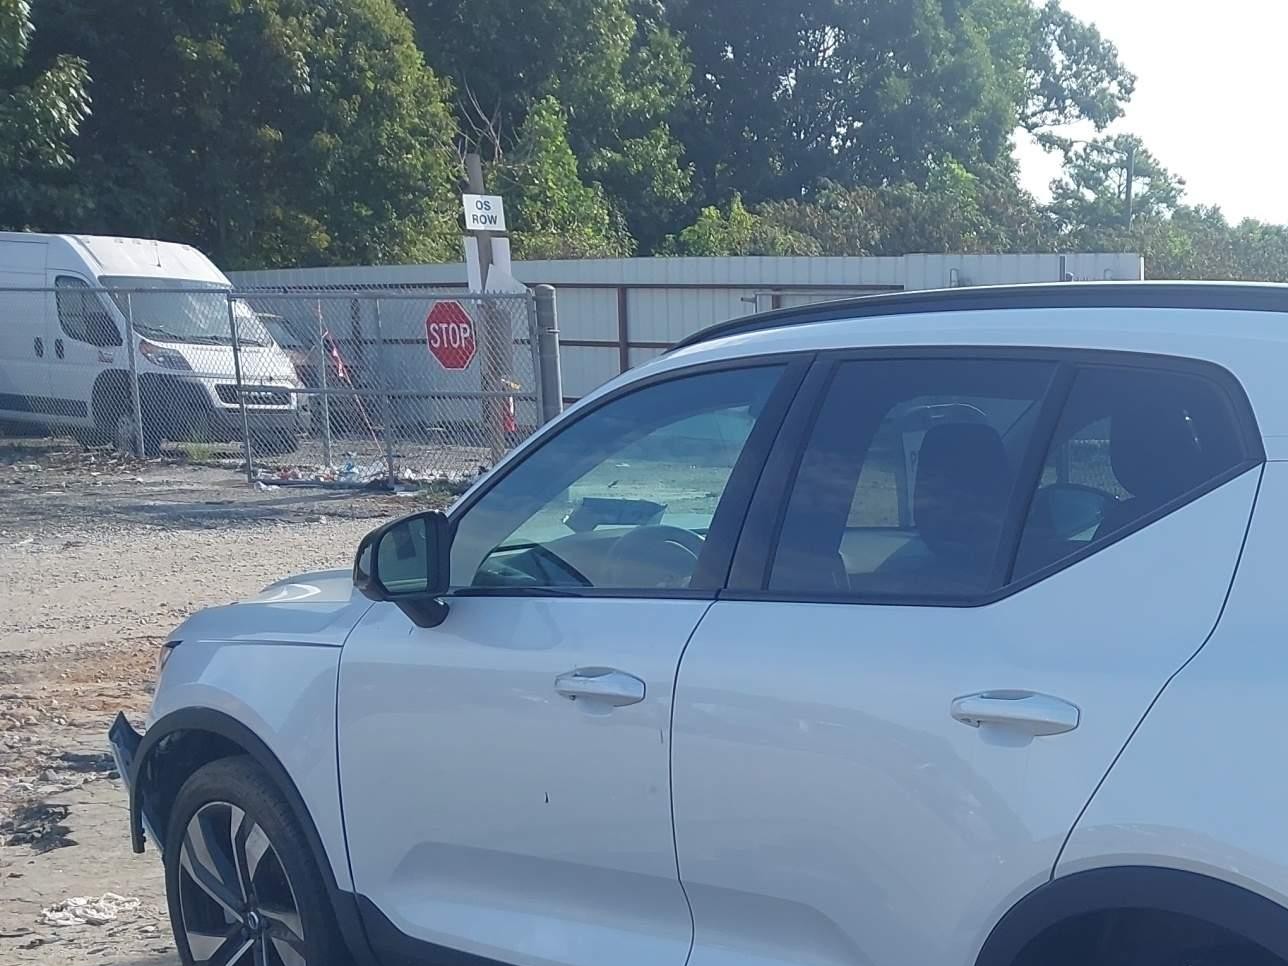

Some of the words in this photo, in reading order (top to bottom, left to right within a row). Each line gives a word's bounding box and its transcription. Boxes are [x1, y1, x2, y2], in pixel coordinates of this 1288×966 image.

[475, 200, 491, 211] OS
[472, 213, 498, 225] ROW
[430, 322, 470, 348] STOP
